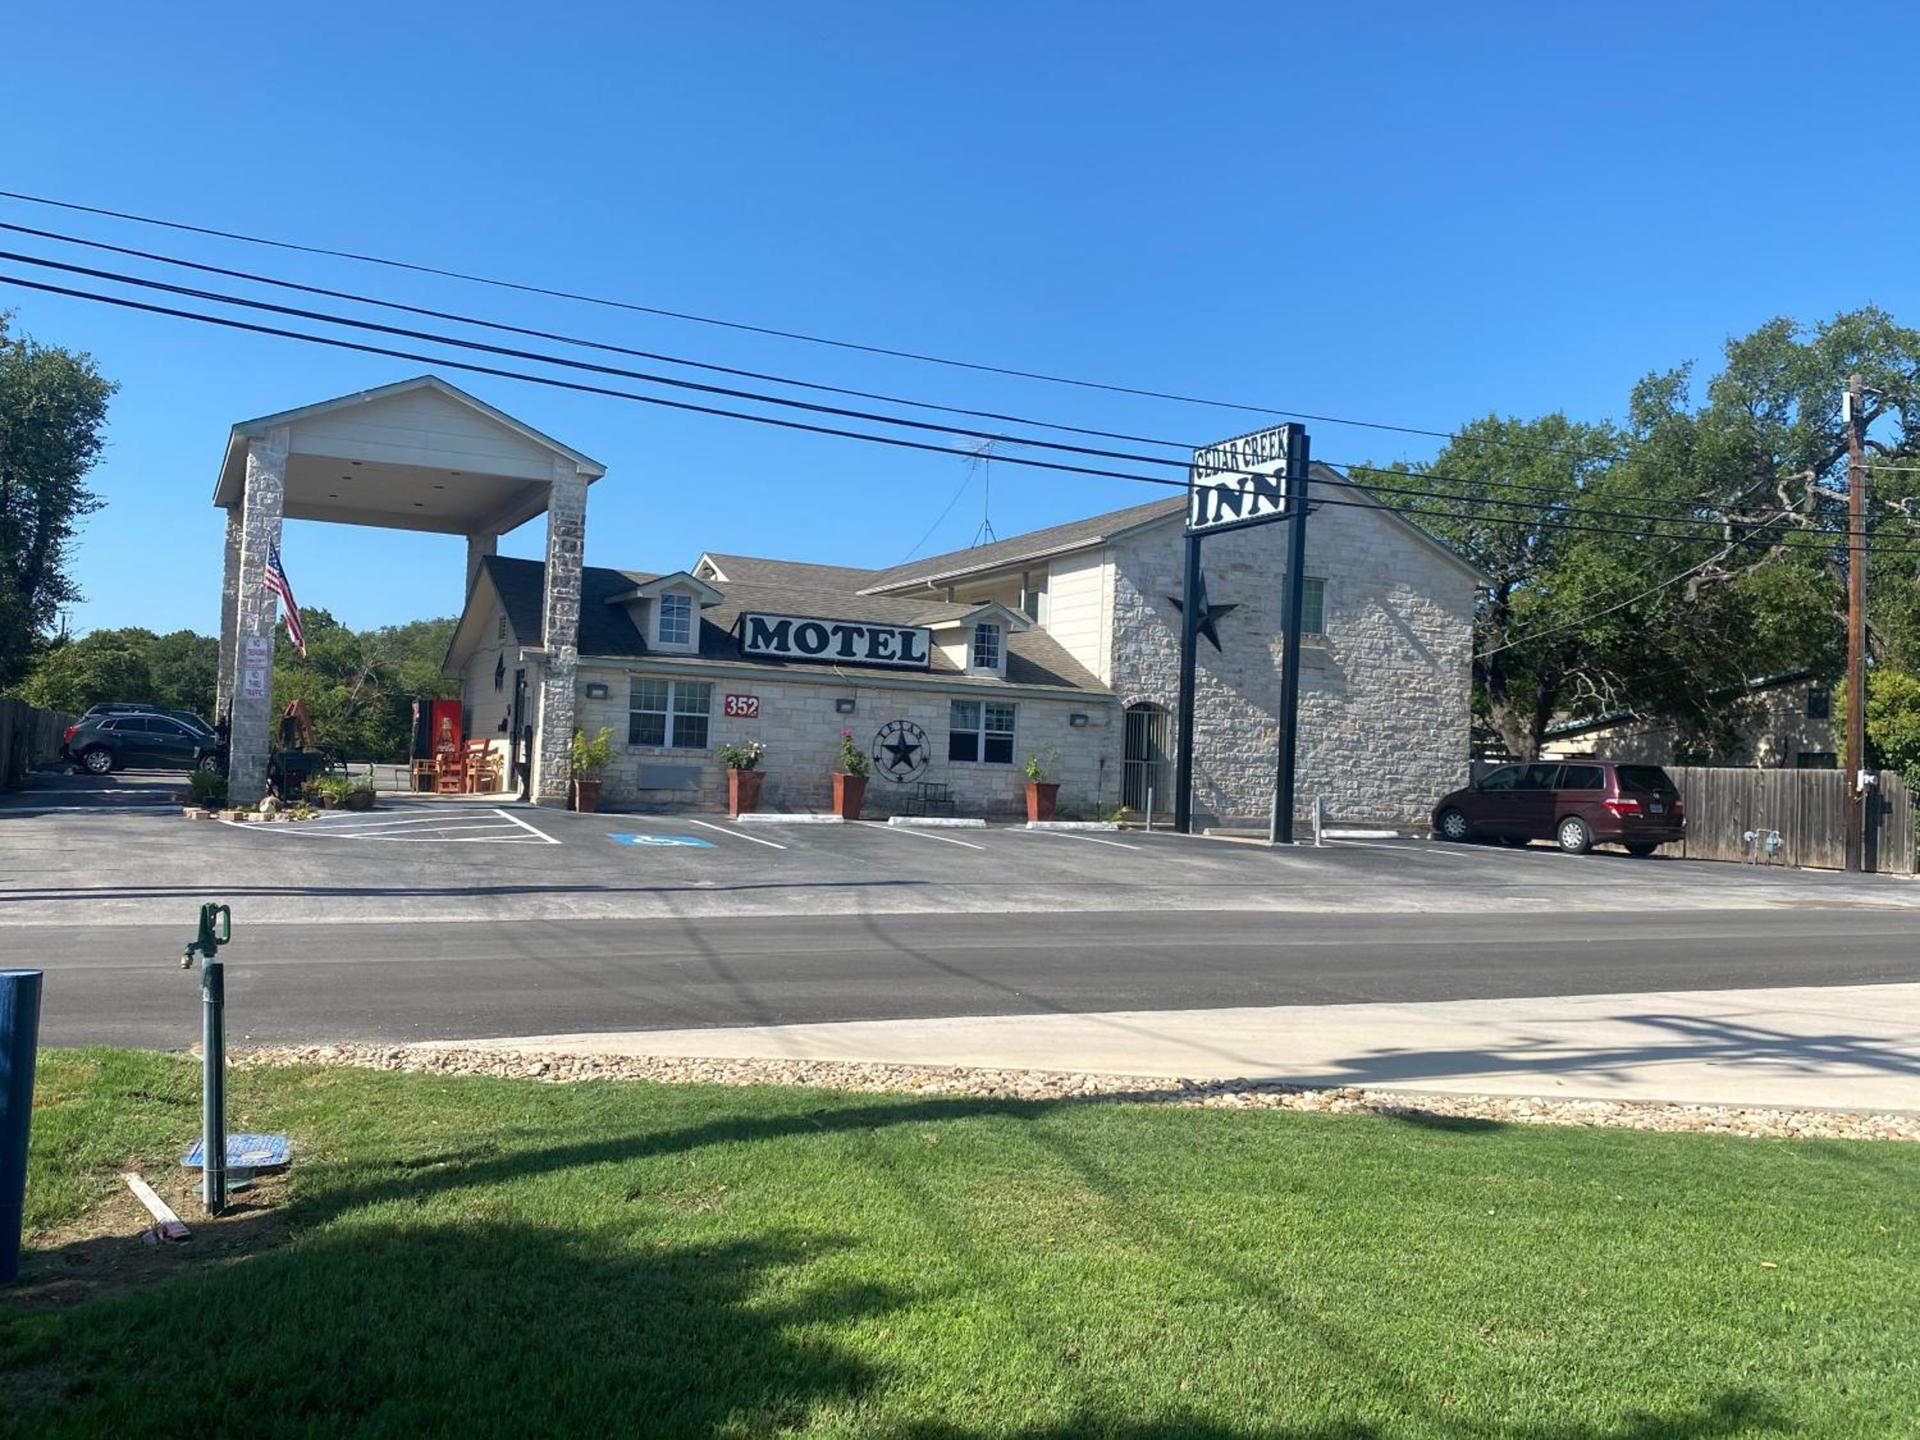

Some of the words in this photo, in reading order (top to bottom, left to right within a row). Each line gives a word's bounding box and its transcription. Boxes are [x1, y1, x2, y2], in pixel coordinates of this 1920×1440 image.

[1195, 443, 1240, 480] CEDAR
[1242, 428, 1287, 468] CREEK
[1194, 467, 1285, 526] INN
[747, 617, 926, 662] MOTEL
[727, 695, 758, 717] 352
[877, 720, 926, 740] TEXAS
